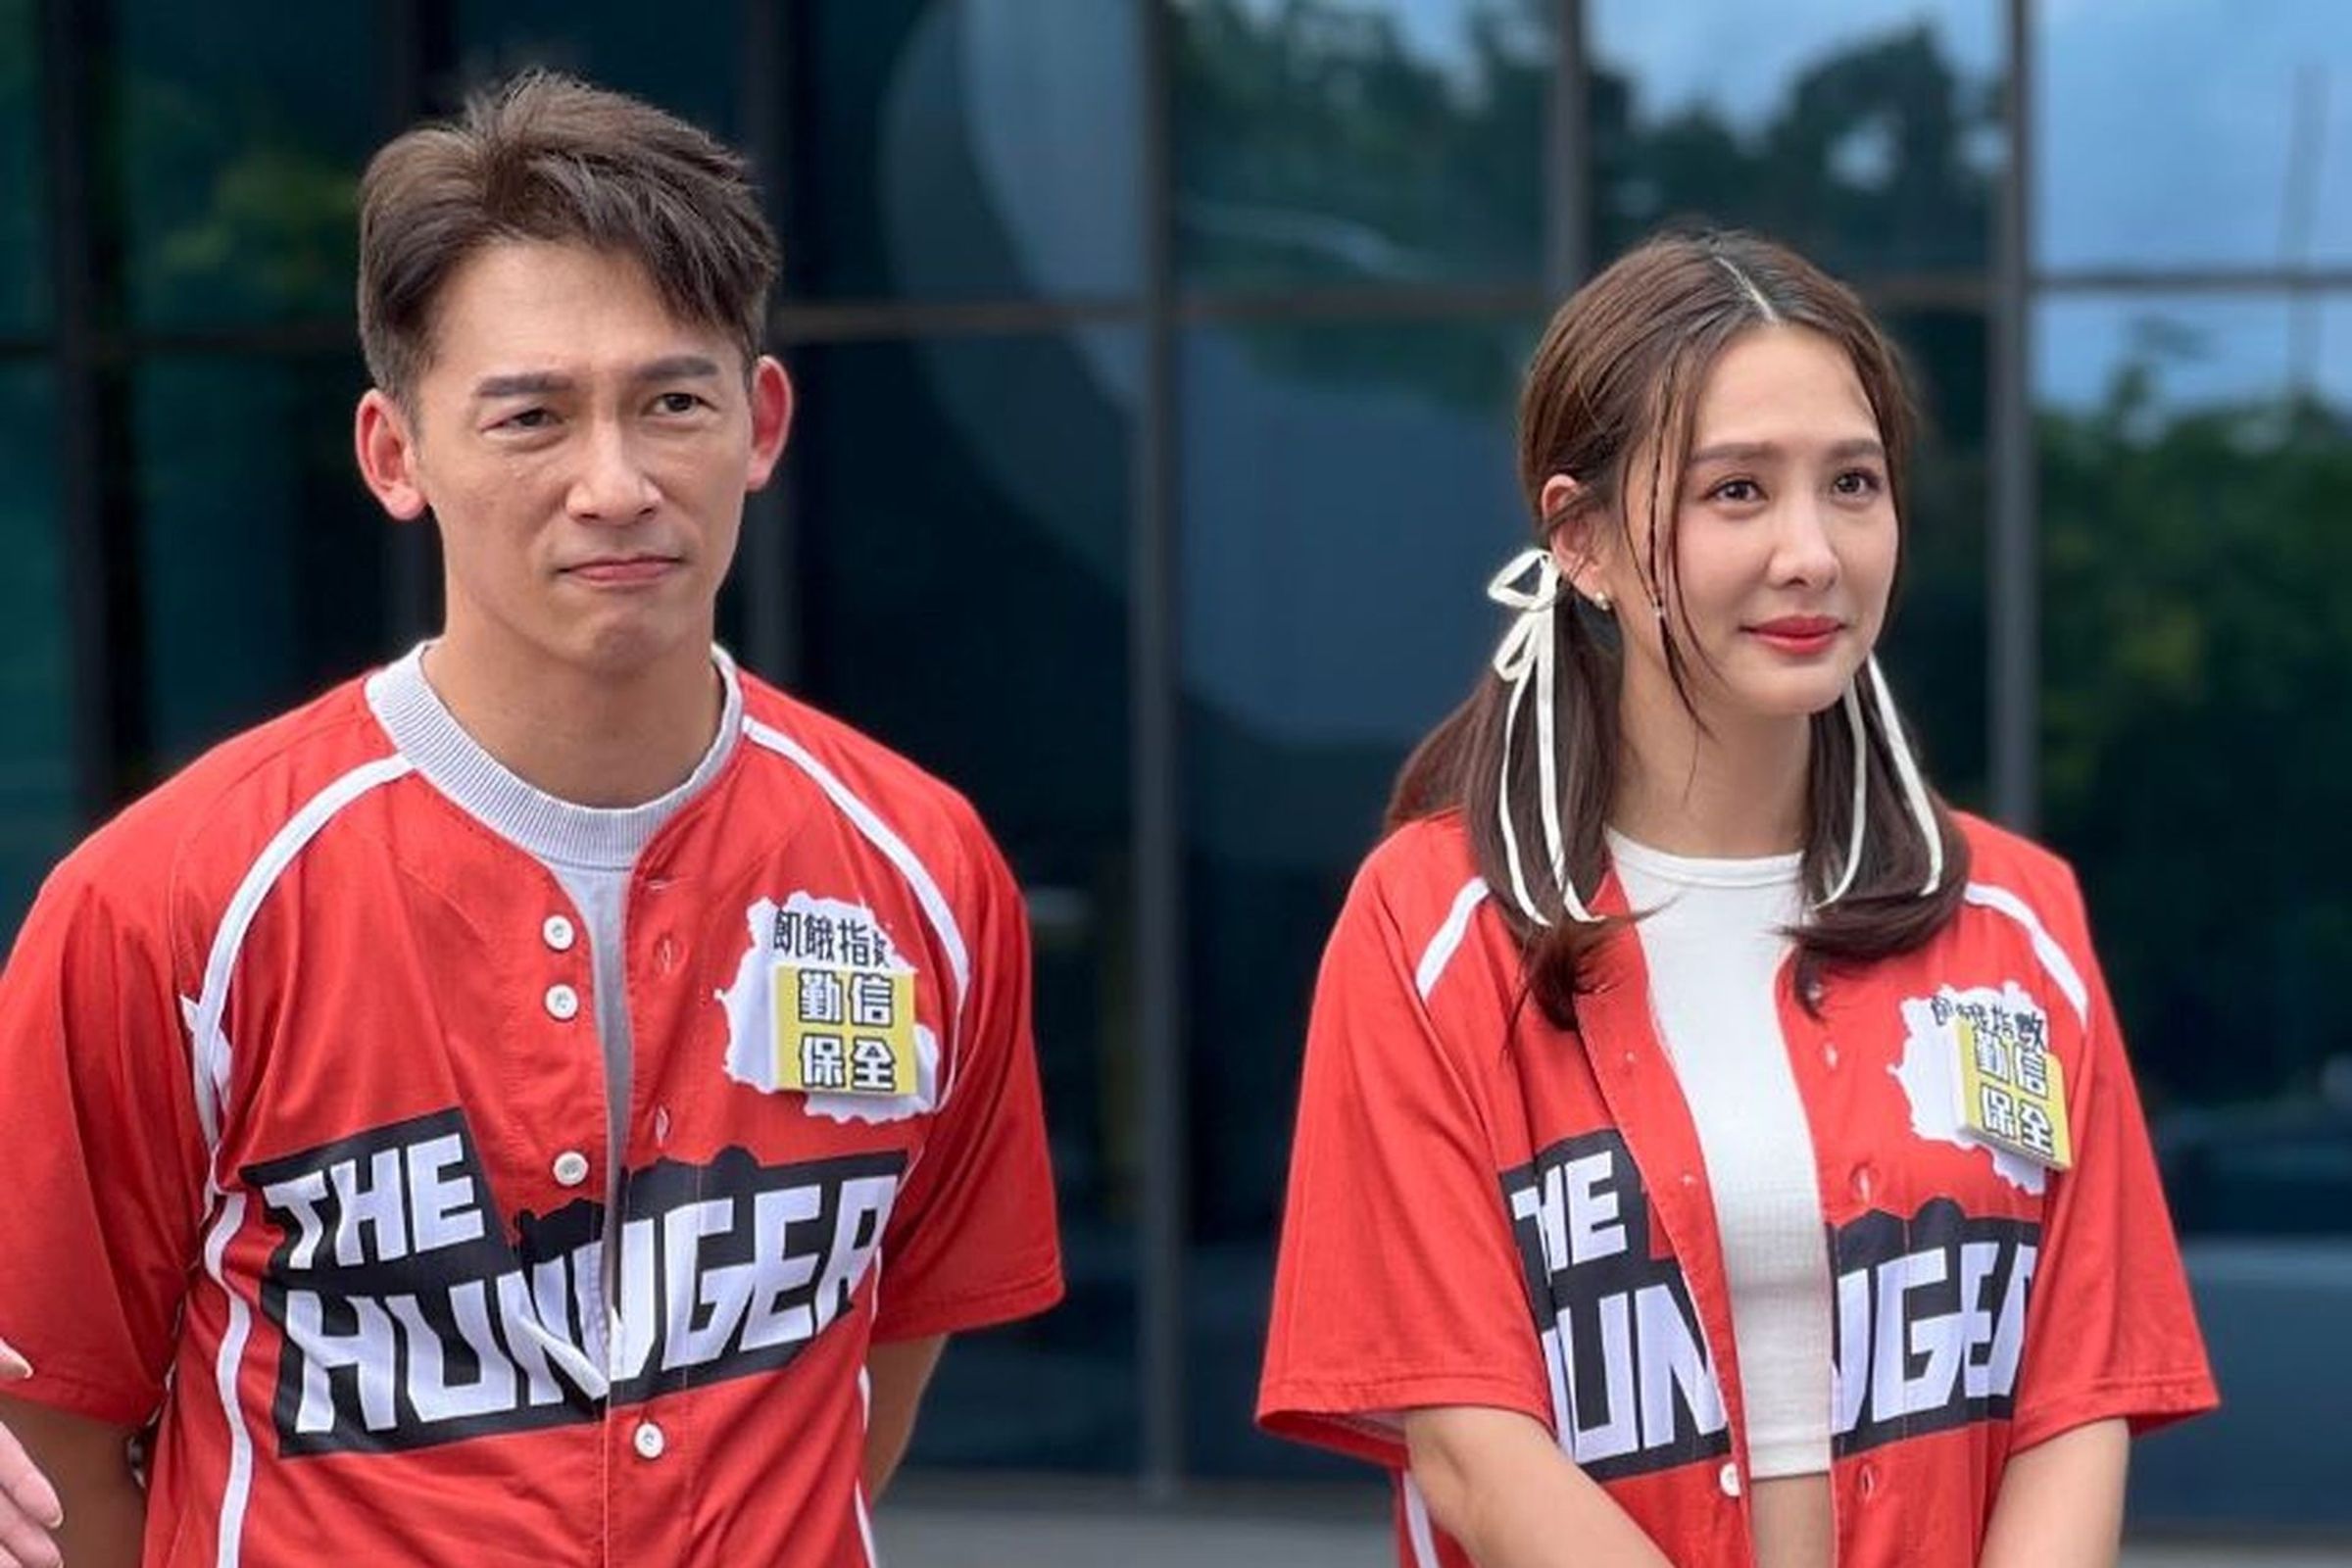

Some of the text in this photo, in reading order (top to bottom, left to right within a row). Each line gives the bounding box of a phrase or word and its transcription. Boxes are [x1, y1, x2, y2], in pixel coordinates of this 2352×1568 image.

[798, 968, 893, 1028] 勤信
[799, 1033, 896, 1092] 保全
[1980, 1082, 2054, 1156] 保全
[263, 1132, 485, 1269] THE
